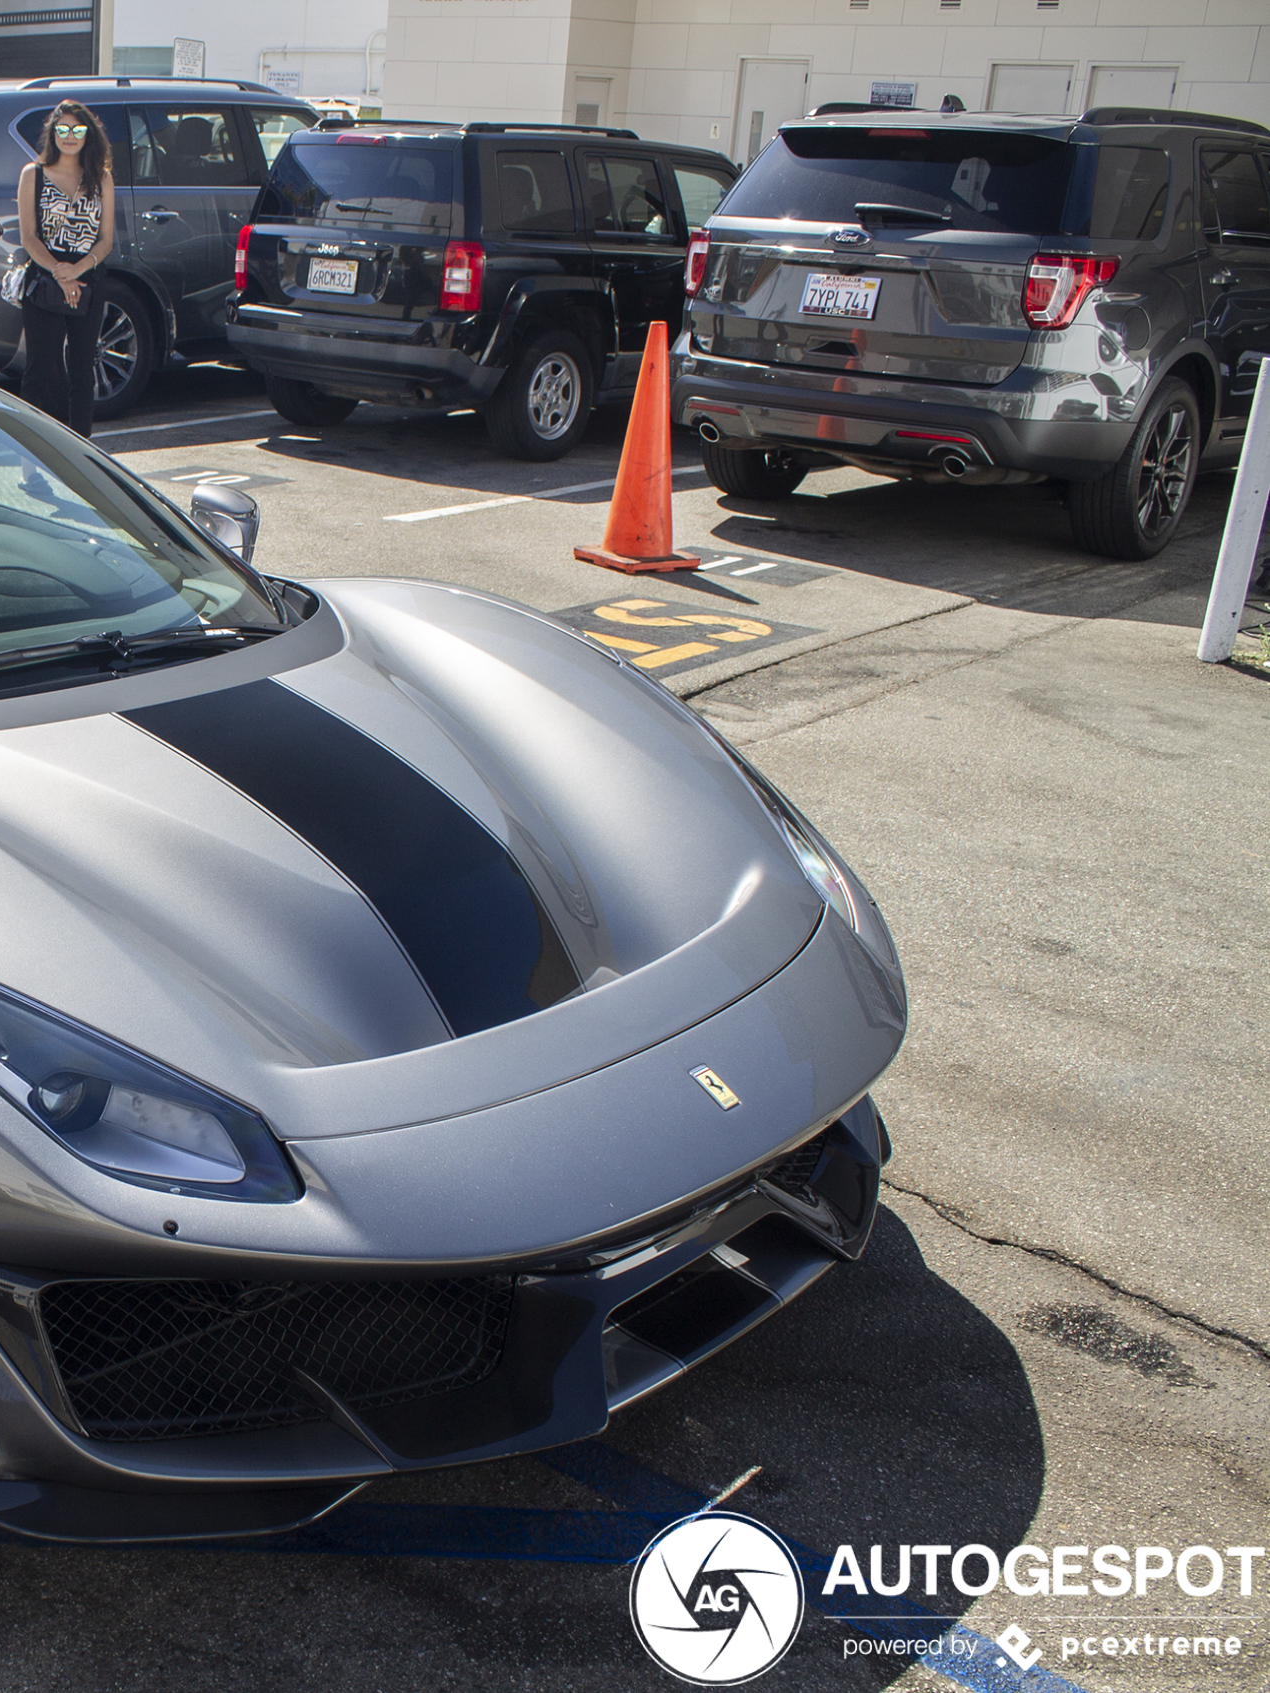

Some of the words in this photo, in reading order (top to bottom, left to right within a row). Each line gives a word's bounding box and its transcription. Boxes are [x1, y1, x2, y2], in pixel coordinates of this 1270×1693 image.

[835, 233, 859, 242] Ford
[317, 243, 339, 256] Jeep
[312, 270, 352, 288] 6RCM321
[821, 280, 861, 290] California
[809, 288, 869, 310] 7YPL741
[825, 307, 846, 315] USC
